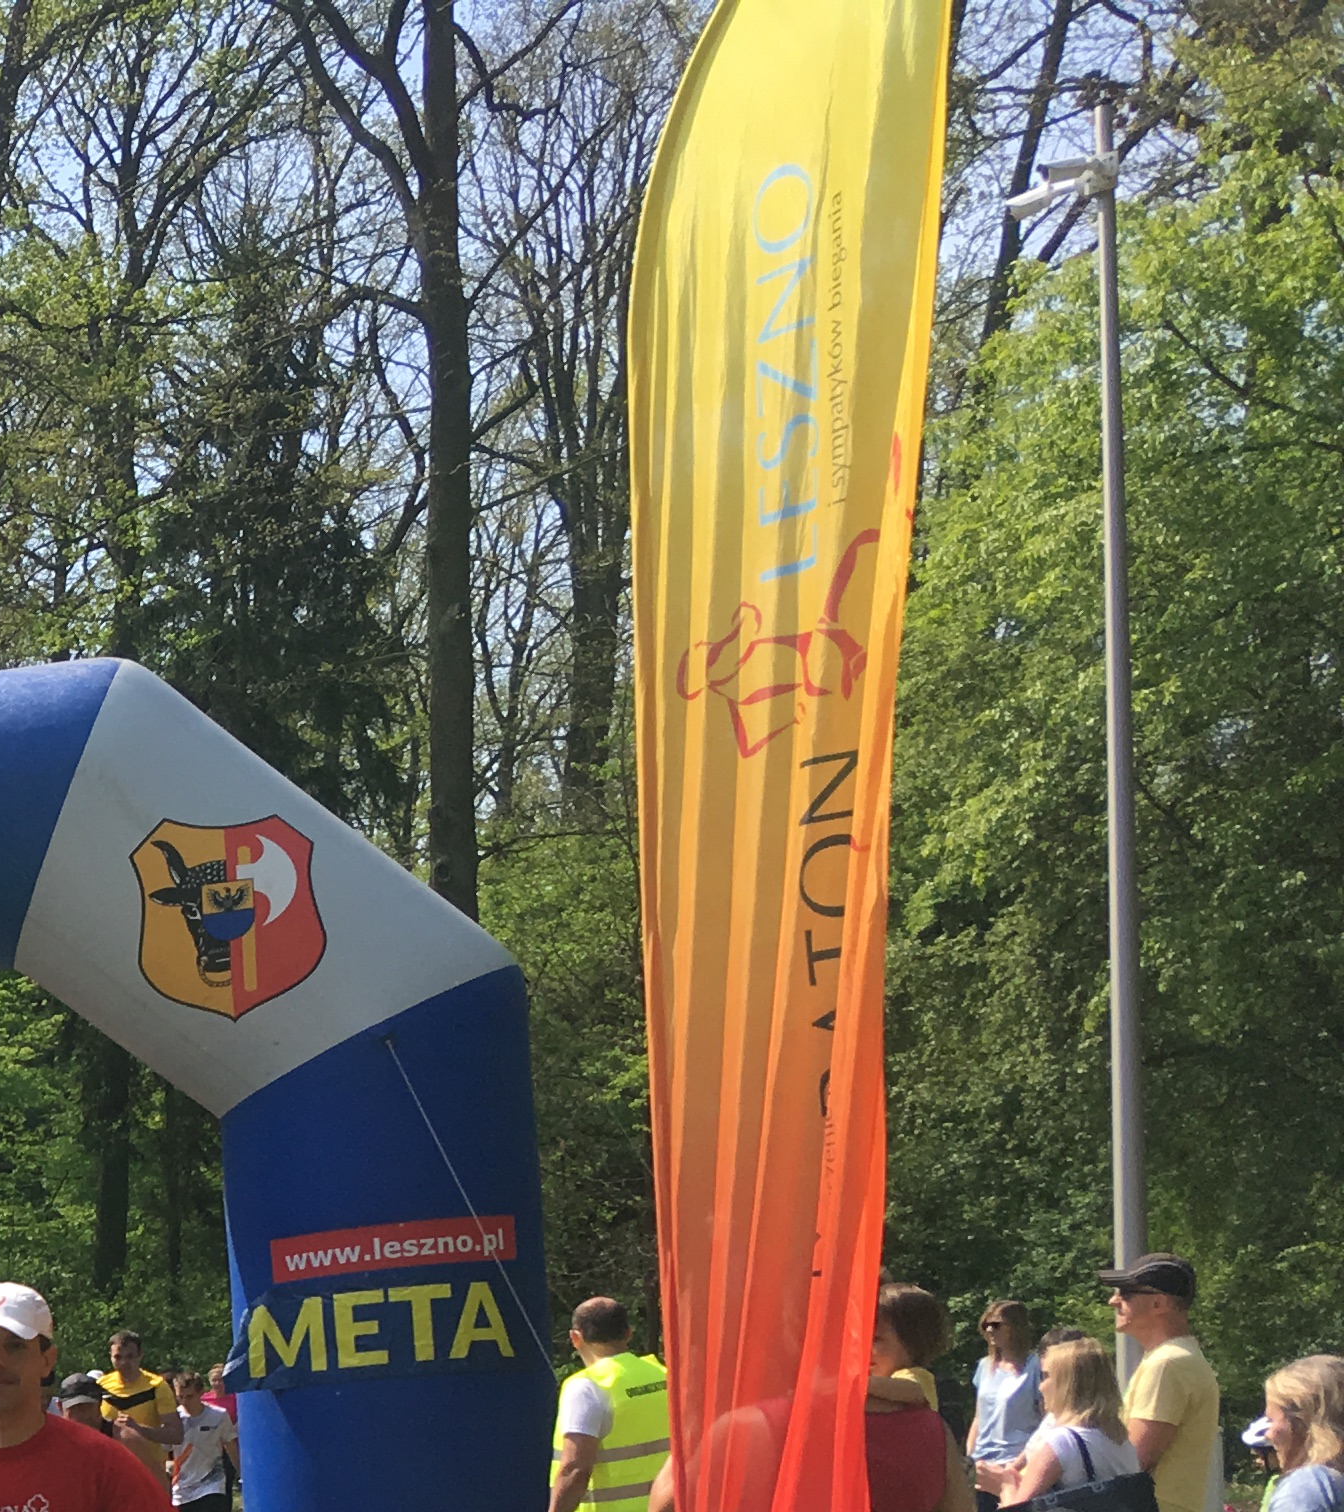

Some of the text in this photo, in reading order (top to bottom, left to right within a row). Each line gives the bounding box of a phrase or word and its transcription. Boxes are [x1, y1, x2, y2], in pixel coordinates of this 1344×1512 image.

[826, 190, 848, 312] biegania
[753, 162, 819, 583] LESZNO
[825, 319, 851, 489] sympatyków
[285, 1228, 504, 1273] www.leszno.pl
[247, 1281, 515, 1379] META
